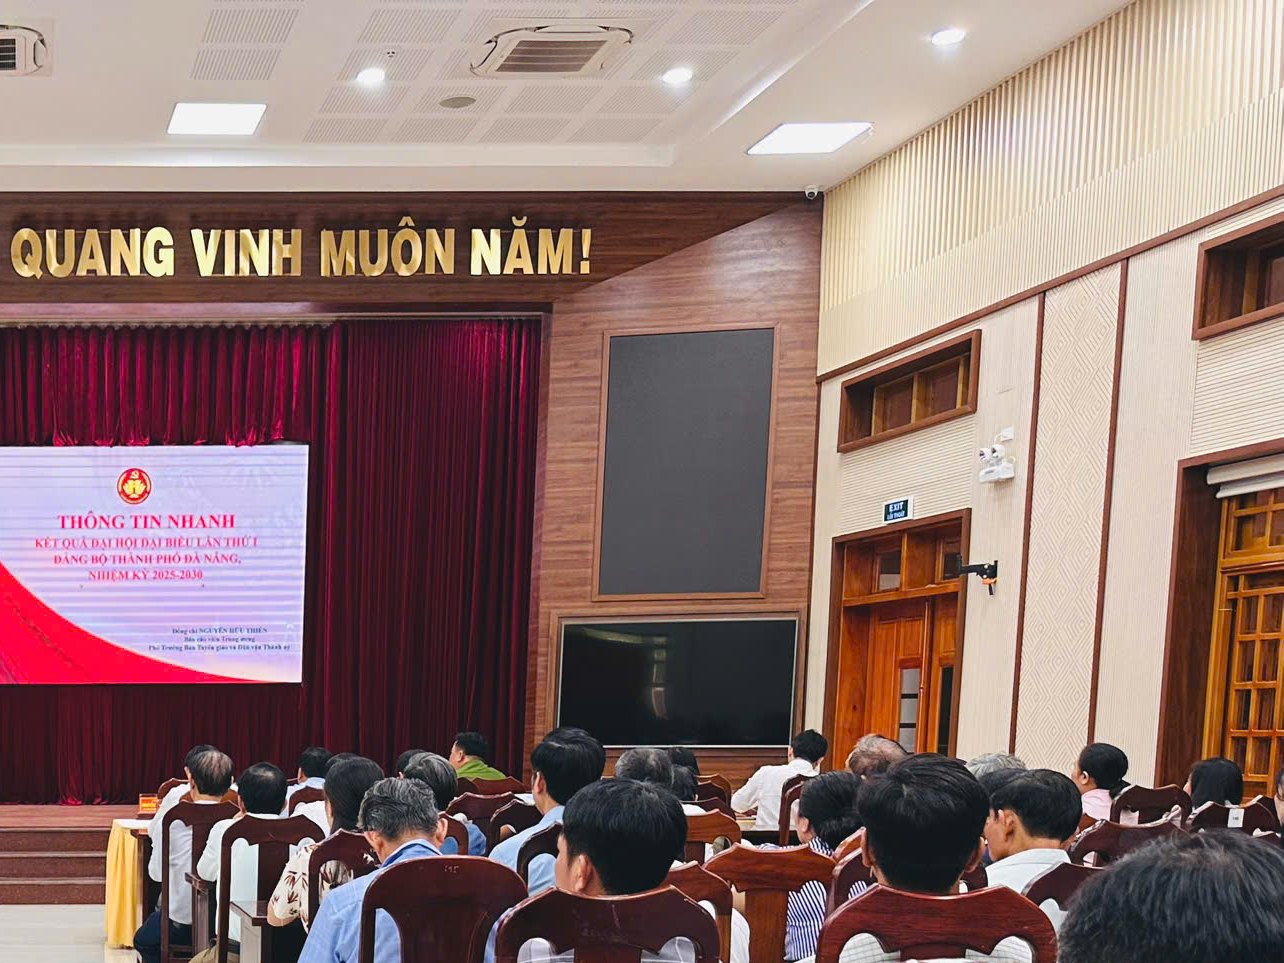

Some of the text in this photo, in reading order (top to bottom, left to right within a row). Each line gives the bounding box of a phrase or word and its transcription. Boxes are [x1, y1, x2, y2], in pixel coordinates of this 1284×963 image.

[10, 226, 175, 279] QUANG
[191, 228, 302, 277] VINH
[320, 216, 456, 277] MUÔN
[470, 217, 593, 276] NĂM!
[889, 501, 903, 512] EXIT
[57, 510, 235, 529] THÔNG TIN NHANH
[35, 536, 58, 548] KẾT
[62, 536, 88, 550] QUẢ
[91, 537, 112, 550] ĐẠI
[116, 537, 137, 550] HỘI
[141, 537, 162, 550] ĐẠI
[166, 535, 193, 548] BIỂU
[54, 552, 88, 565] ĐẢNG
[91, 553, 108, 566] BỘ
[111, 552, 153, 564] THÀNH
[156, 551, 181, 564] PHỐ
[185, 551, 201, 564] ĐÀ
[88, 568, 203, 582] NHIỆM KỲ 2025-2030
